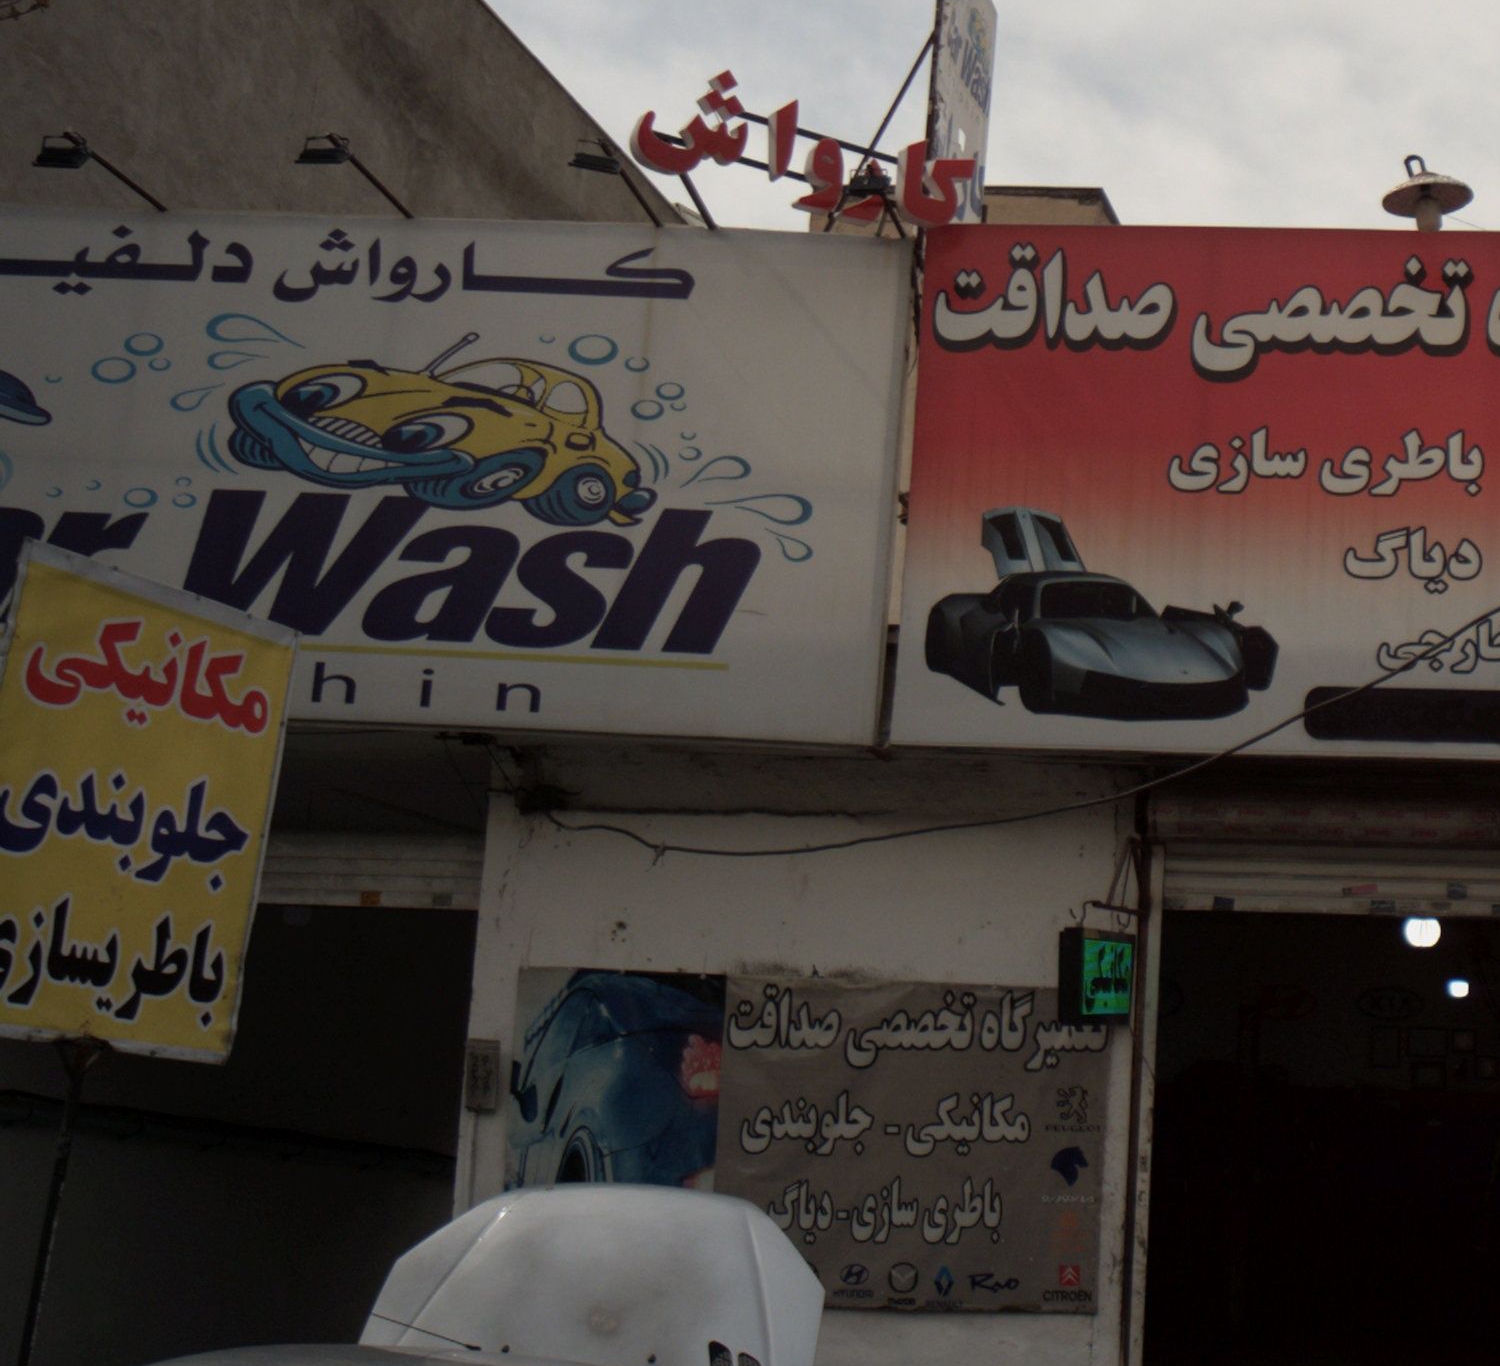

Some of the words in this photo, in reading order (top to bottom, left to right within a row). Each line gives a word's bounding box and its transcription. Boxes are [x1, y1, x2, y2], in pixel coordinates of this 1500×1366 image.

[0, 224, 254, 296] دلفی
[272, 227, 696, 303] کارواش
[931, 243, 1176, 351] صداقت
[1190, 255, 1471, 382] تخصصی
[1168, 427, 1307, 493] سازی
[1319, 428, 1484, 496] باطری
[183, 488, 762, 656] Wash
[1344, 527, 1482, 593] دیاگ
[26, 620, 268, 734] مکانیکی
[0, 772, 249, 892] جلوبندی
[726, 984, 842, 1051] صداقت
[845, 989, 976, 1069] تخصصی
[740, 1090, 874, 1156] جلوبندی
[905, 1093, 1031, 1155] مکانیکی
[1044, 1124, 1101, 1133] PEUGEOT
[850, 1176, 919, 1243] سازی
[923, 1177, 1002, 1244] باطری
